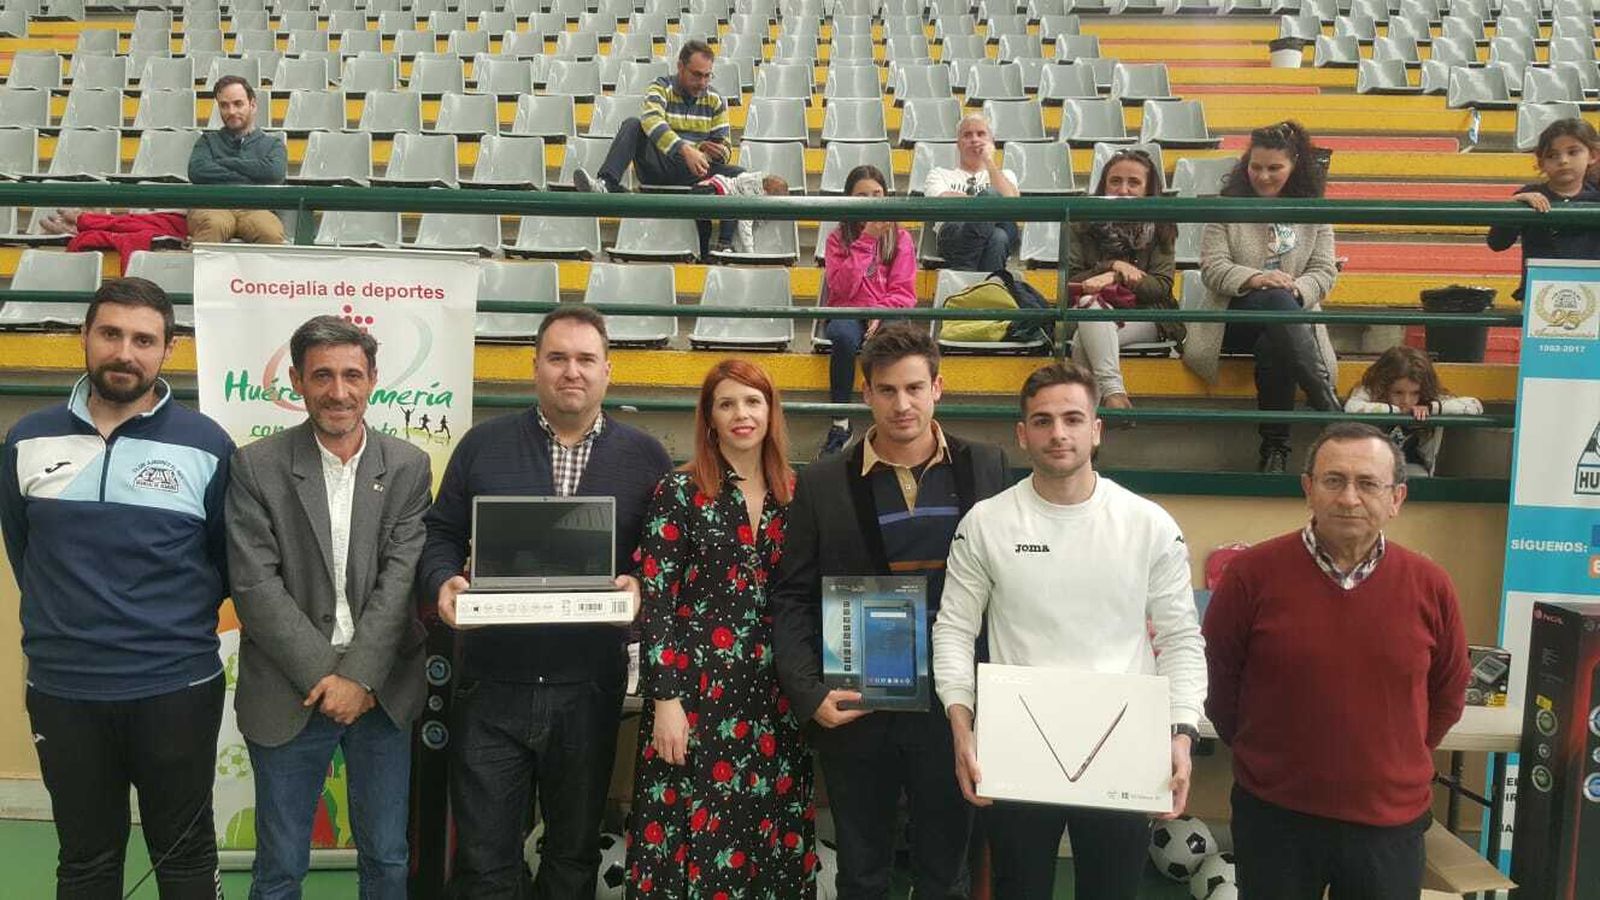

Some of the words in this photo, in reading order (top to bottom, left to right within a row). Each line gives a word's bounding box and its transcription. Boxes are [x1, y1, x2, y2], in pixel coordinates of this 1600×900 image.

[230, 278, 328, 299] Concejalía
[334, 281, 356, 297] de
[362, 282, 446, 301] deportes
[224, 369, 303, 402] Huérc
[368, 382, 454, 408] mería
[1579, 471, 1600, 489] HU
[1511, 536, 1588, 553] SÍGUENOS:
